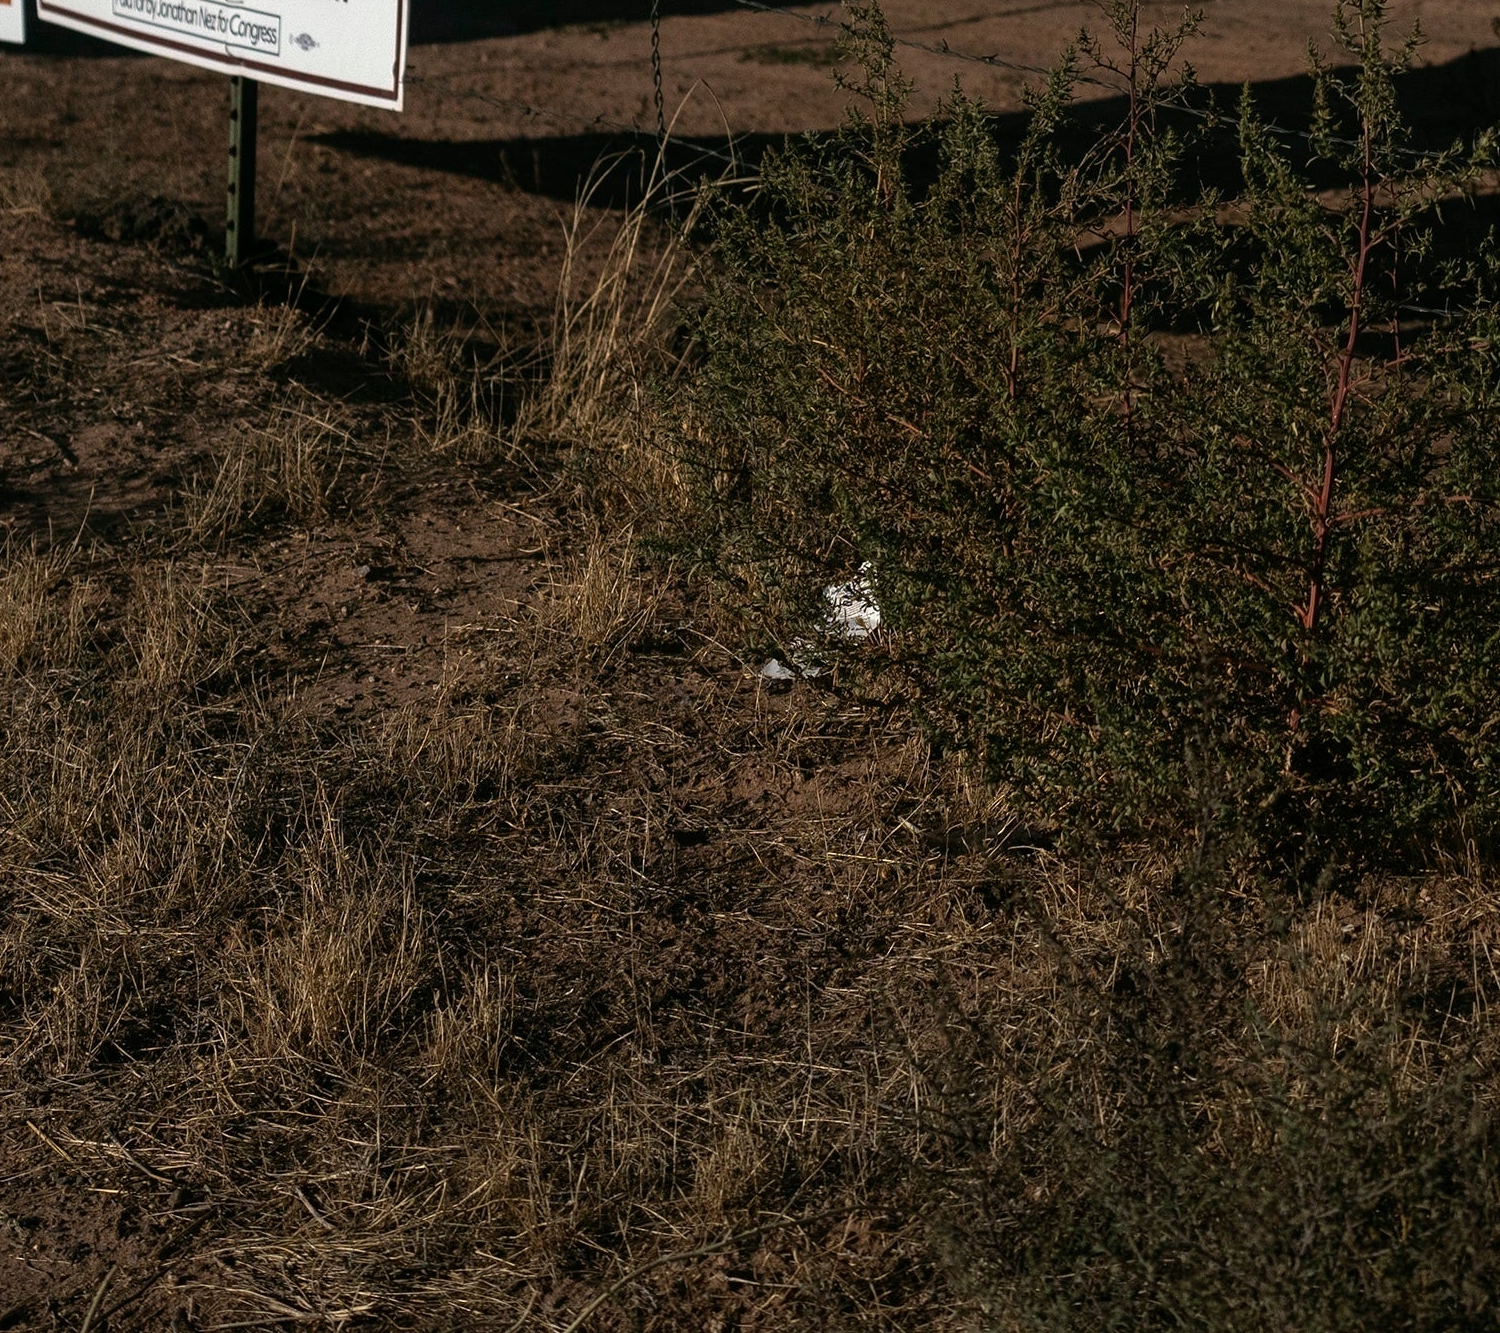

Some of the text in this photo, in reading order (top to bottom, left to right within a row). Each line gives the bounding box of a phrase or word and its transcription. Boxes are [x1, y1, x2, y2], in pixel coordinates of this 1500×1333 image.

[199, 7, 216, 30] Nez
[217, 11, 228, 32] for
[229, 13, 278, 46] Congress
